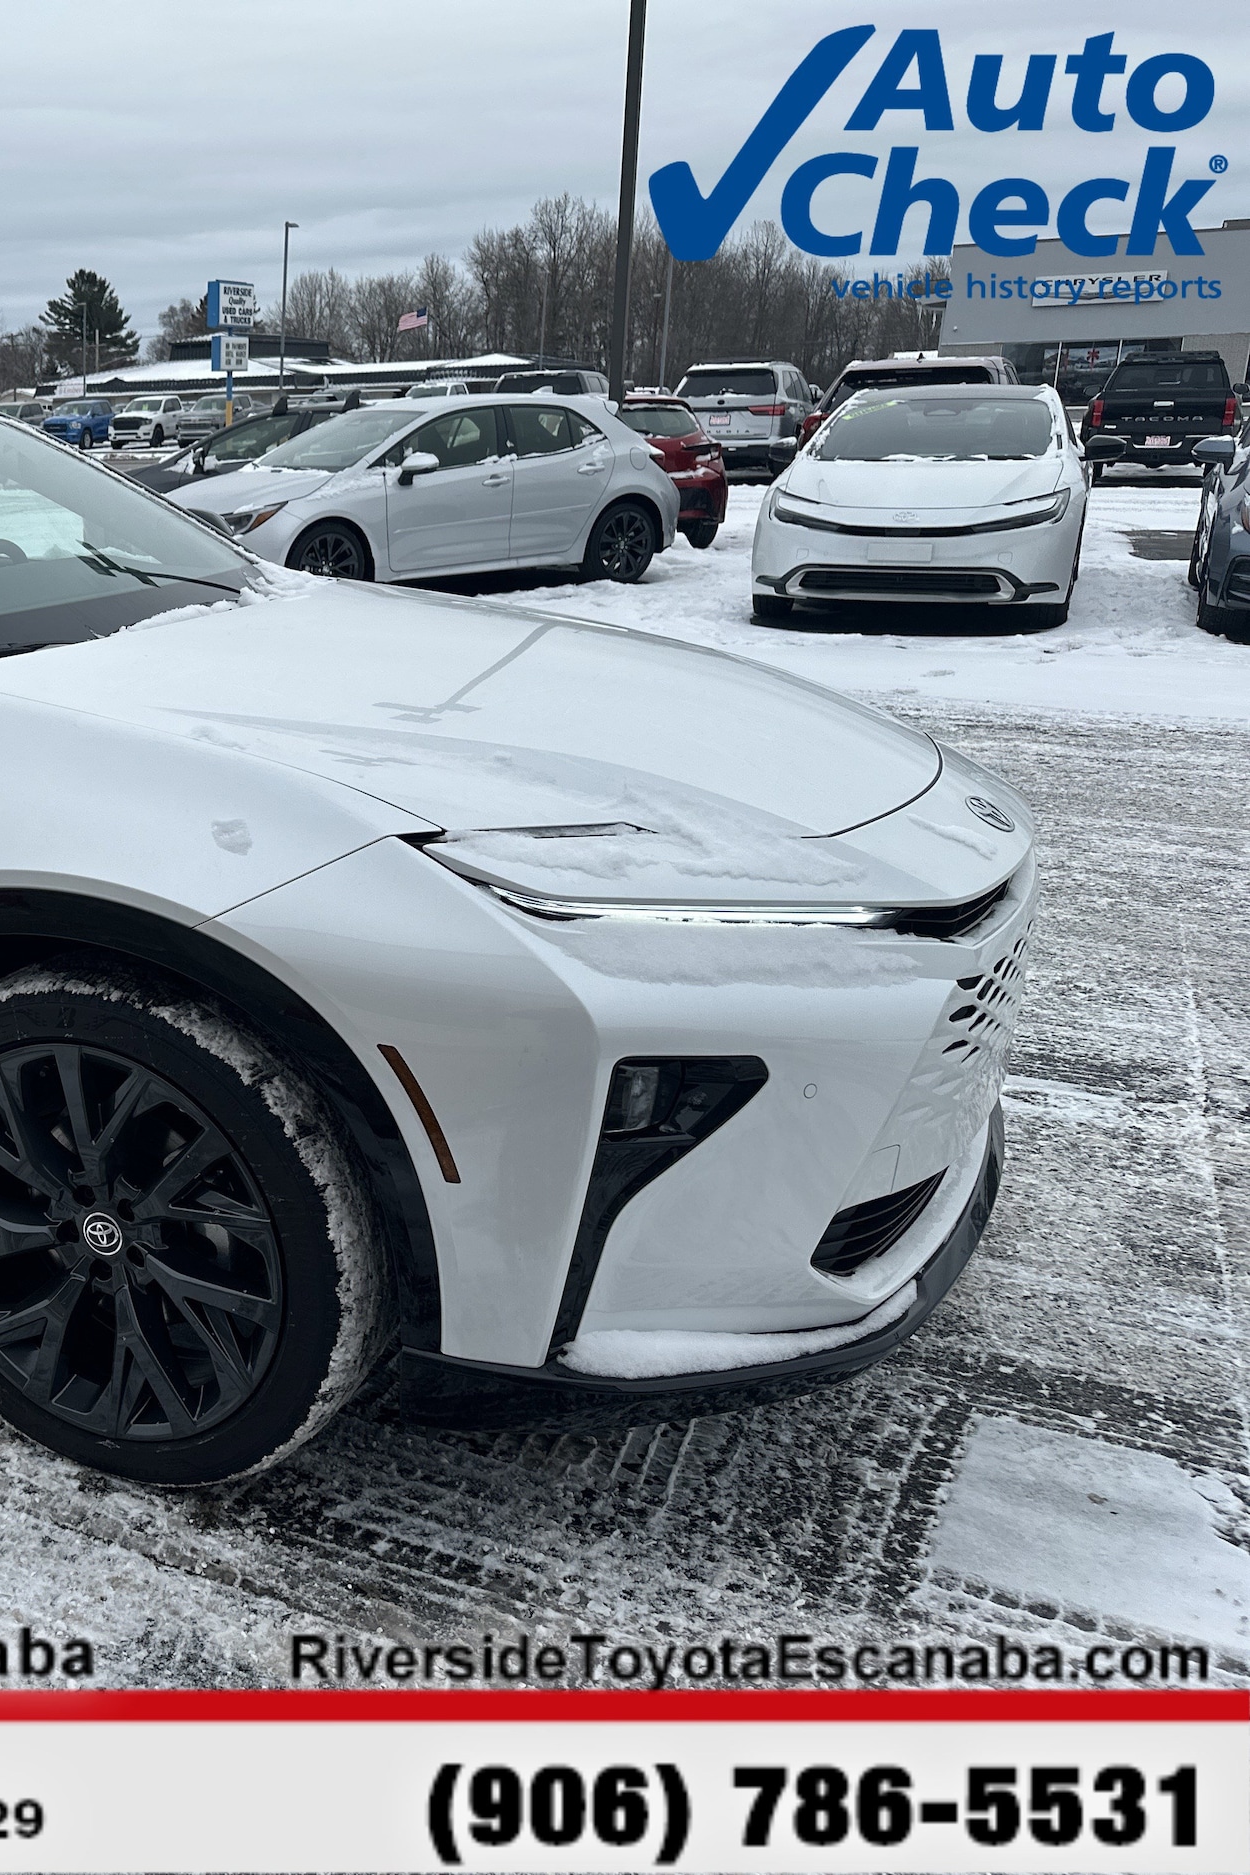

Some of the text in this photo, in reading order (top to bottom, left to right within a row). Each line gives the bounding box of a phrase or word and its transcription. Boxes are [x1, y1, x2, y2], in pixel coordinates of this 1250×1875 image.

[223, 286, 252, 297] RIVERSIDE
[222, 306, 253, 317] USED CARS
[230, 316, 251, 325] TRUCKS
